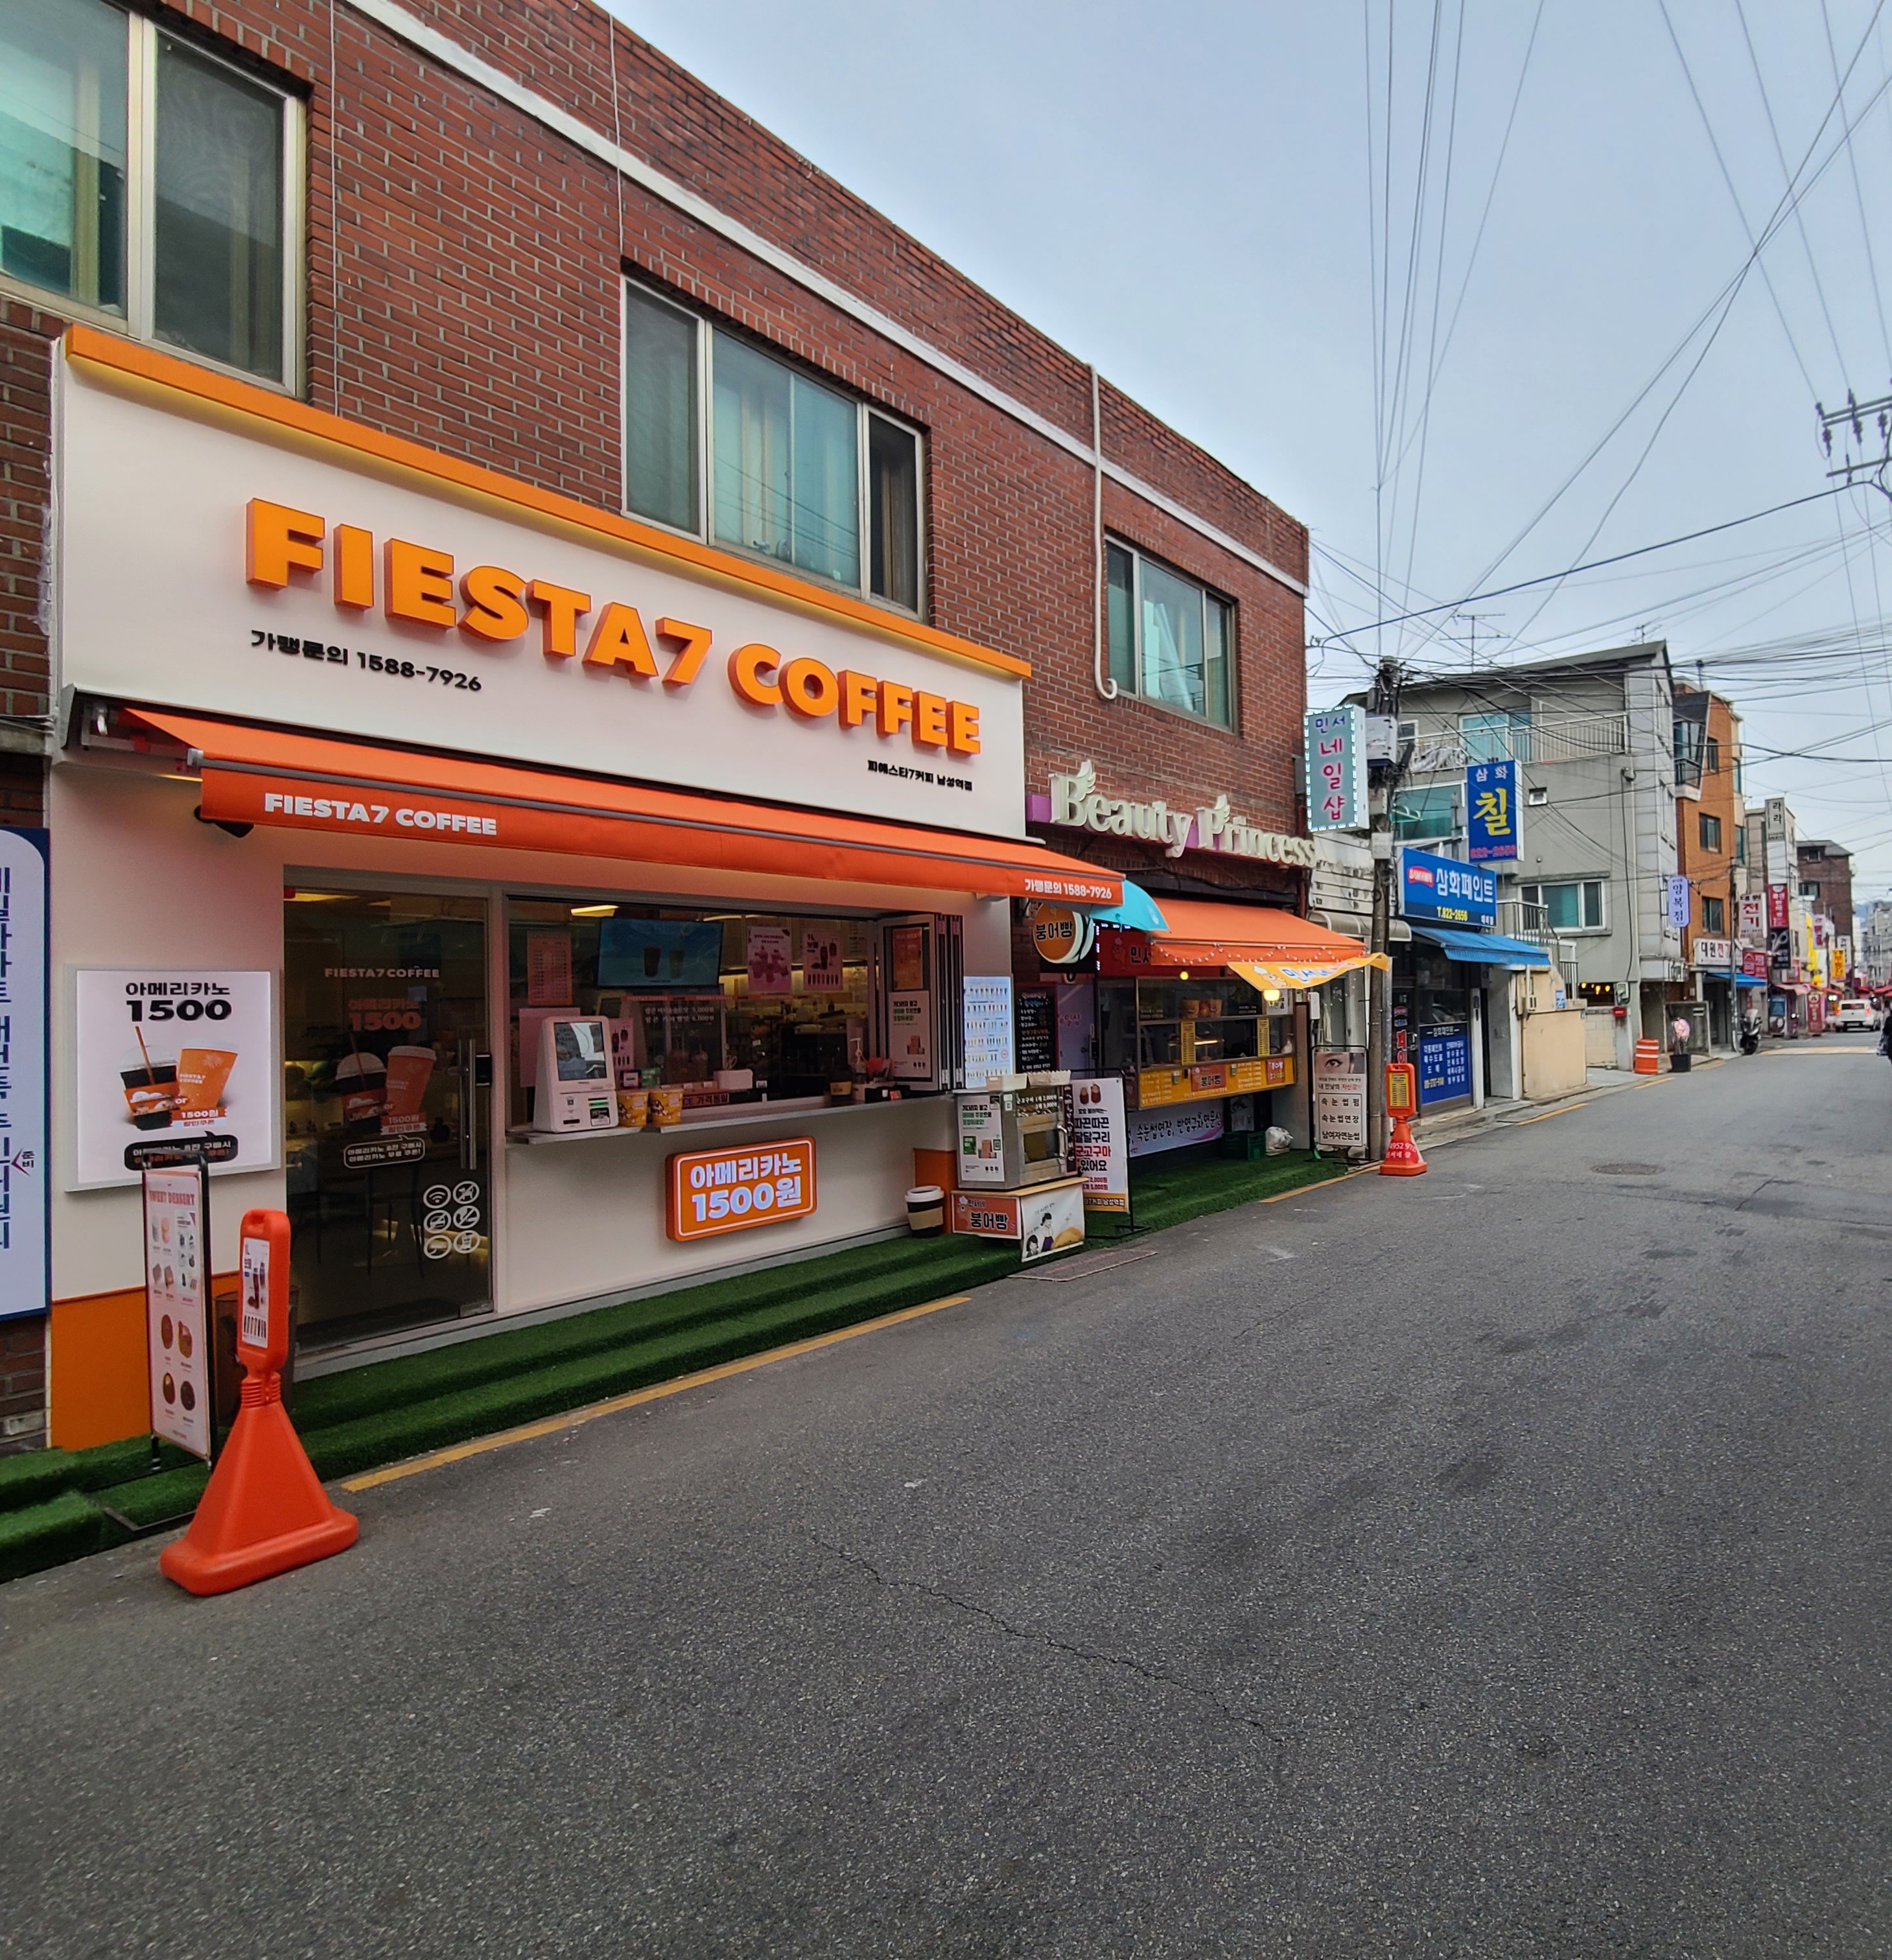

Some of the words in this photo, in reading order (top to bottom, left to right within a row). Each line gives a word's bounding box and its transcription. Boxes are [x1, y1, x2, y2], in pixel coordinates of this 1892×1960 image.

[246, 497, 712, 686] FIESTA7
[727, 643, 981, 756] COFFEE
[251, 629, 348, 666] 가맹문의
[357, 651, 482, 692] 1588-7926
[1315, 716, 1346, 734] 민서
[867, 760, 934, 784] 피에스타7커피
[937, 774, 973, 791] 남성역점
[1320, 738, 1346, 821] 네일샵
[1475, 765, 1508, 783] 삼화
[264, 793, 389, 824] FIESTA7
[395, 808, 497, 836] COFFEE
[1048, 760, 1193, 858] Beauty
[1197, 794, 1318, 868] Princess
[1473, 787, 1512, 836] 칠
[1024, 878, 1062, 894] 가맹문의
[1063, 882, 1112, 900] 1588-7926
[1436, 867, 1493, 904] 삼화페인트
[1672, 884, 1684, 922] 양복점
[1035, 920, 1073, 940] 붕어빵
[325, 968, 387, 977] FIESTA7
[388, 968, 440, 978] COFFEE
[126, 982, 230, 996] 아메리카노
[126, 999, 232, 1022] 1500
[349, 1011, 422, 1031] 1500
[181, 1109, 218, 1119] 1500원
[388, 1115, 419, 1124] 1500원
[1075, 1117, 1110, 1130] 따끈따끈
[1322, 1114, 1359, 1124] 속눈썹연장
[1075, 1131, 1110, 1144] 달달구리
[21, 1150, 35, 1168] 준비
[1075, 1145, 1112, 1158] 군고구마
[690, 1152, 802, 1189] 아메리카노
[1080, 1159, 1108, 1172] 있어요
[691, 1176, 802, 1222] 1500원
[971, 1211, 1009, 1230] 붕어빵
